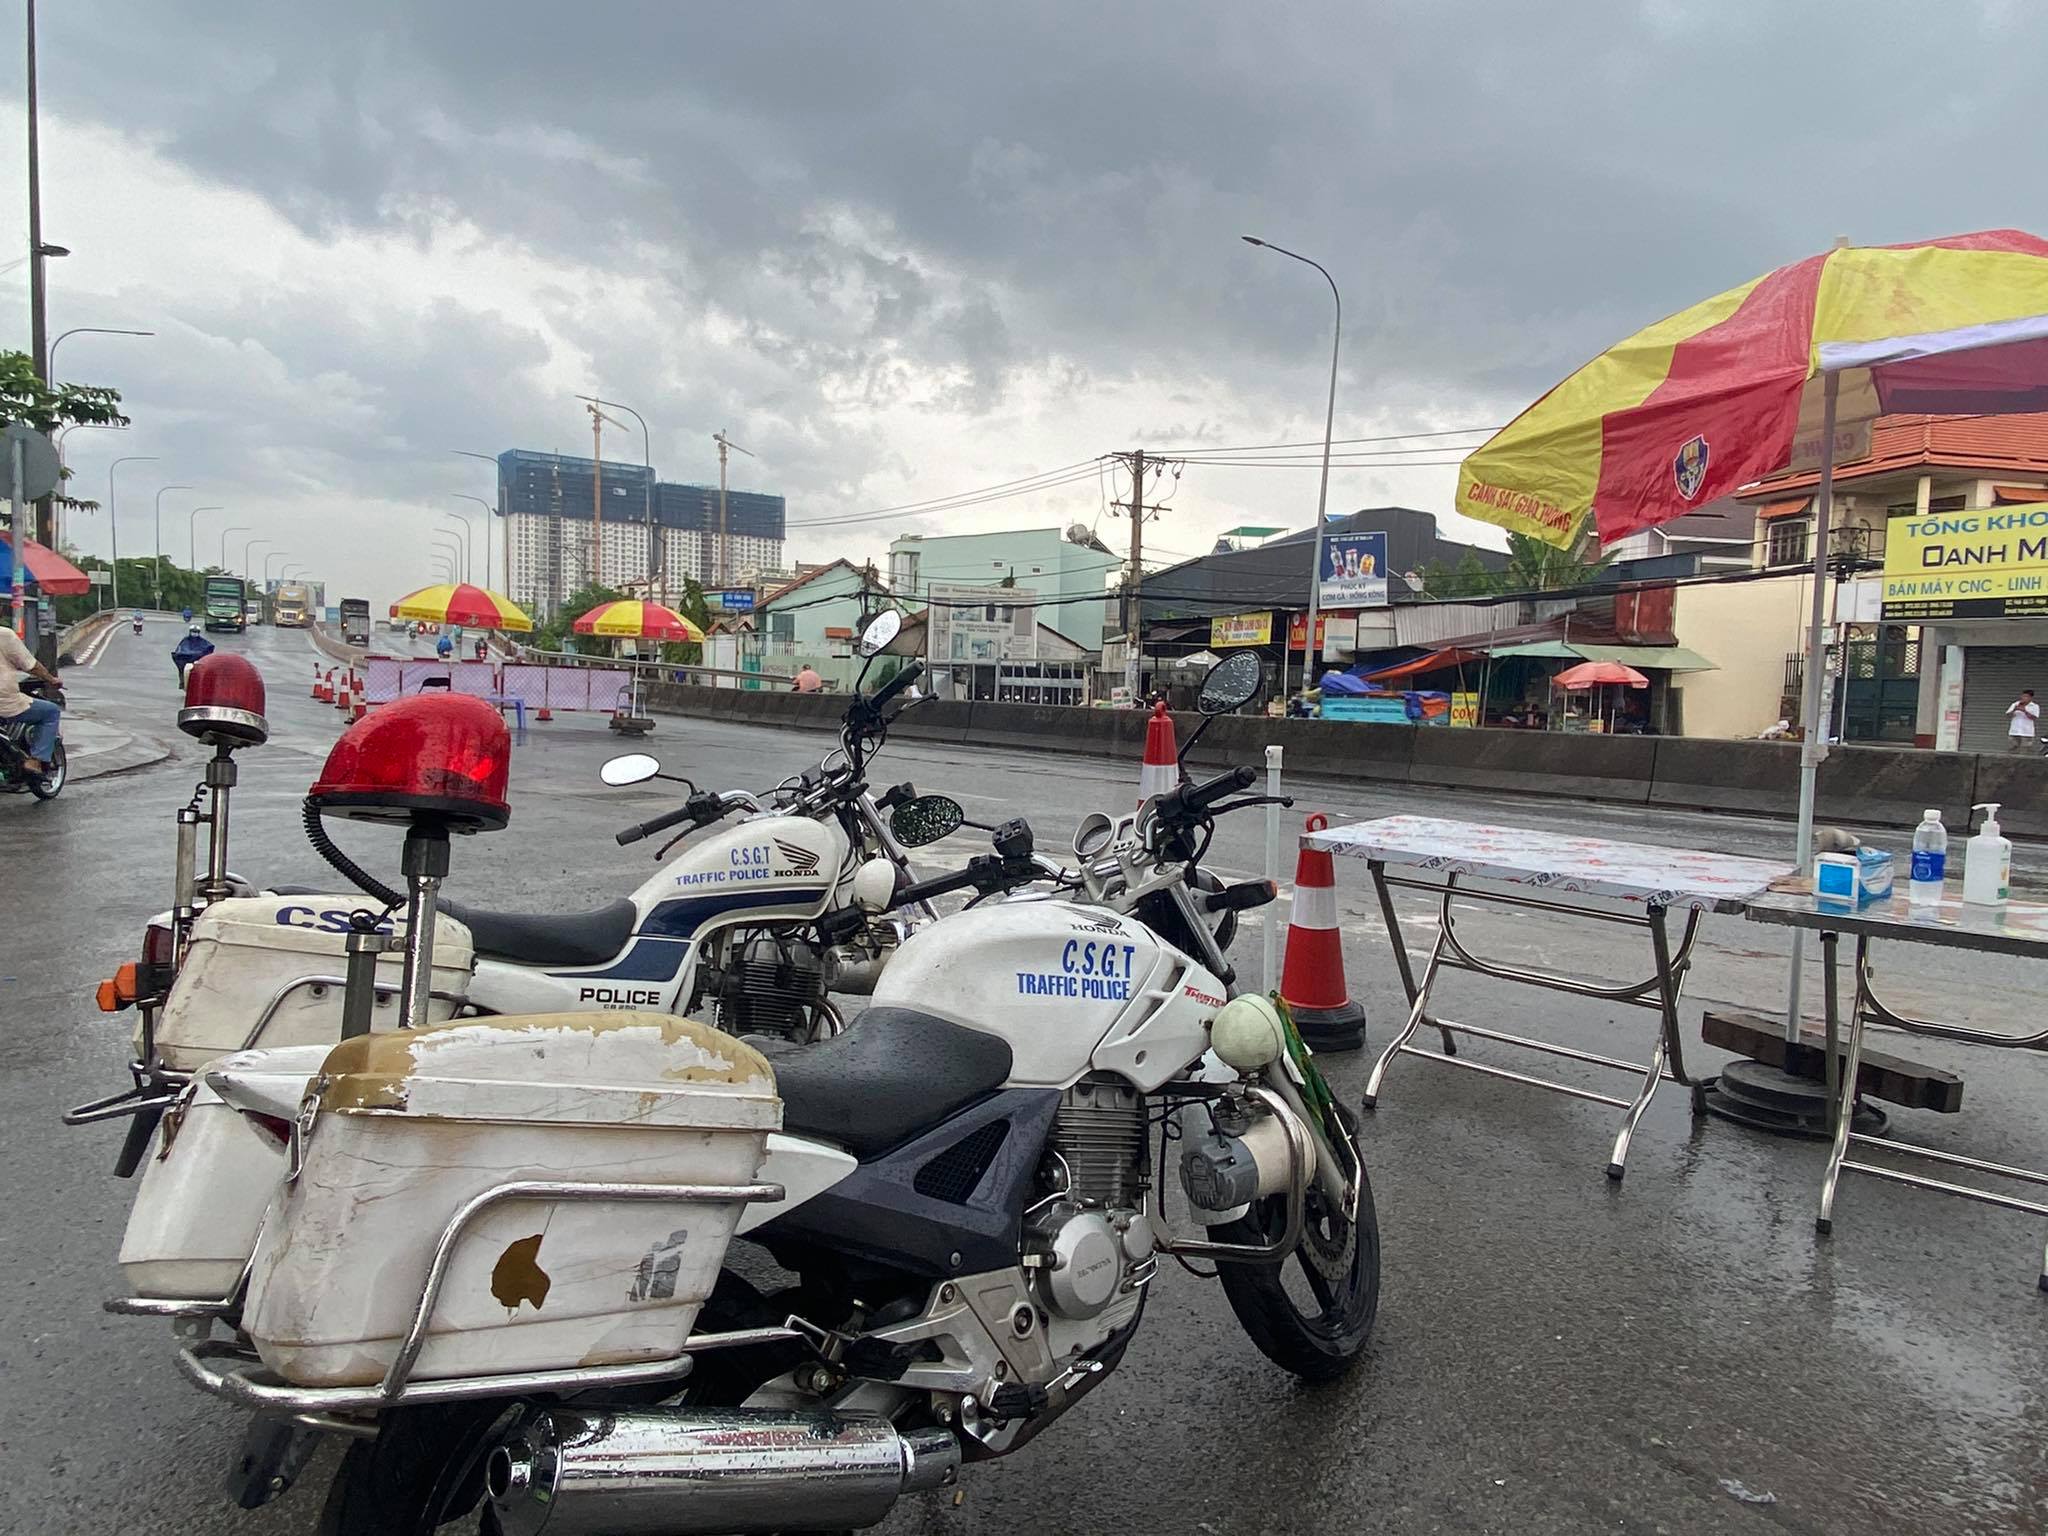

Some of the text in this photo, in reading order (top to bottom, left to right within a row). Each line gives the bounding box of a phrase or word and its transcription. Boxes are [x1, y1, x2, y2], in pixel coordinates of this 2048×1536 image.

[1906, 511, 2048, 537] TỔNG KHO
[1888, 579, 1916, 596] BÁN
[1920, 578, 1953, 595] MÁY
[1958, 579, 1992, 593] CNC
[2008, 576, 2041, 591] LINH
[731, 846, 770, 866] C.S.G.T
[675, 868, 770, 886] TRAFFIC POLICE
[774, 869, 820, 877] HONDA
[1070, 924, 1132, 939] HONDA
[1062, 939, 1135, 978] C.S.G.T
[580, 987, 660, 1005] POLICE
[1016, 973, 1130, 1001] TRAFFIC POLICE
